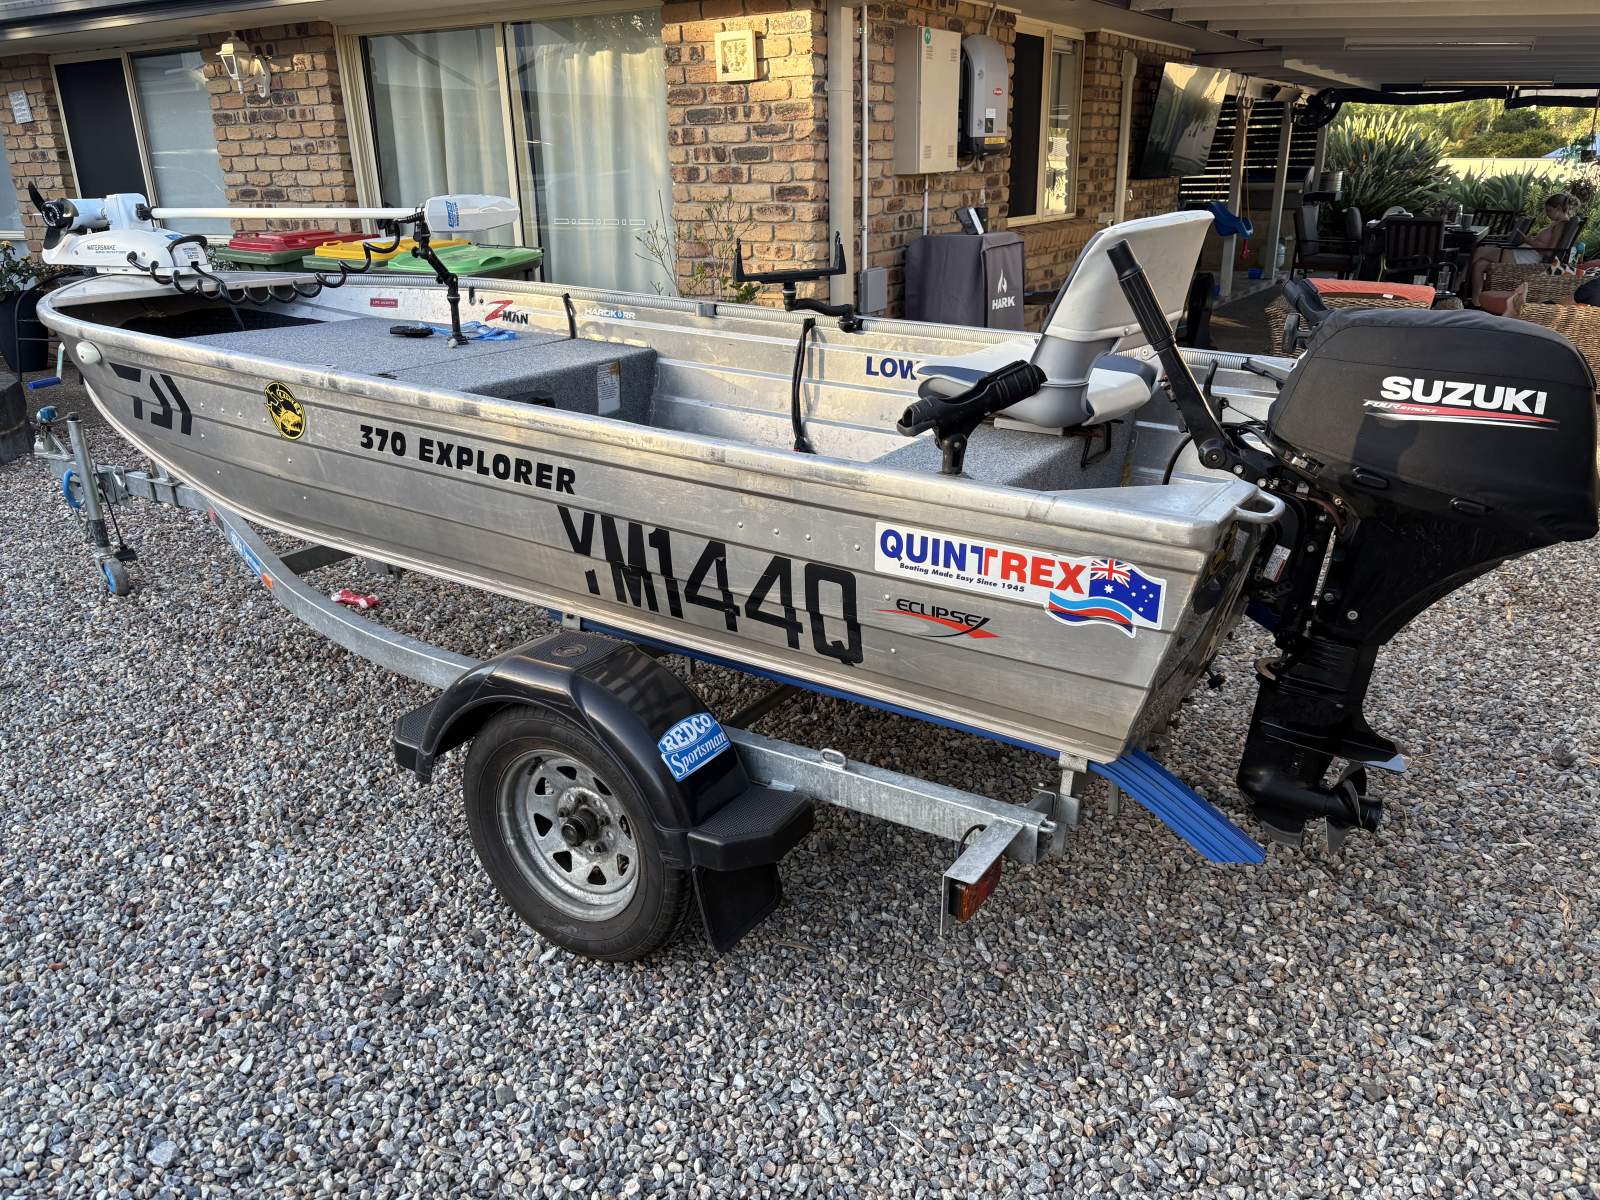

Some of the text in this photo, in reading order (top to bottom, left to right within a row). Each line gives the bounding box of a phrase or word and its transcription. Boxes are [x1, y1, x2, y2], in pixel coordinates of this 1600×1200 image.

[992, 296, 1015, 310] HARK
[1380, 375, 1548, 415] SUZUKI
[360, 424, 576, 495] 370 EXPLORER
[880, 528, 1087, 595] QUINTREX
[899, 562, 1025, 593] Boating Made Easy Since 1945
[557, 505, 864, 666] YM144Q
[896, 599, 984, 627] ECLIPSE
[661, 715, 711, 751] REDCO
[670, 732, 727, 776] Sportsman
